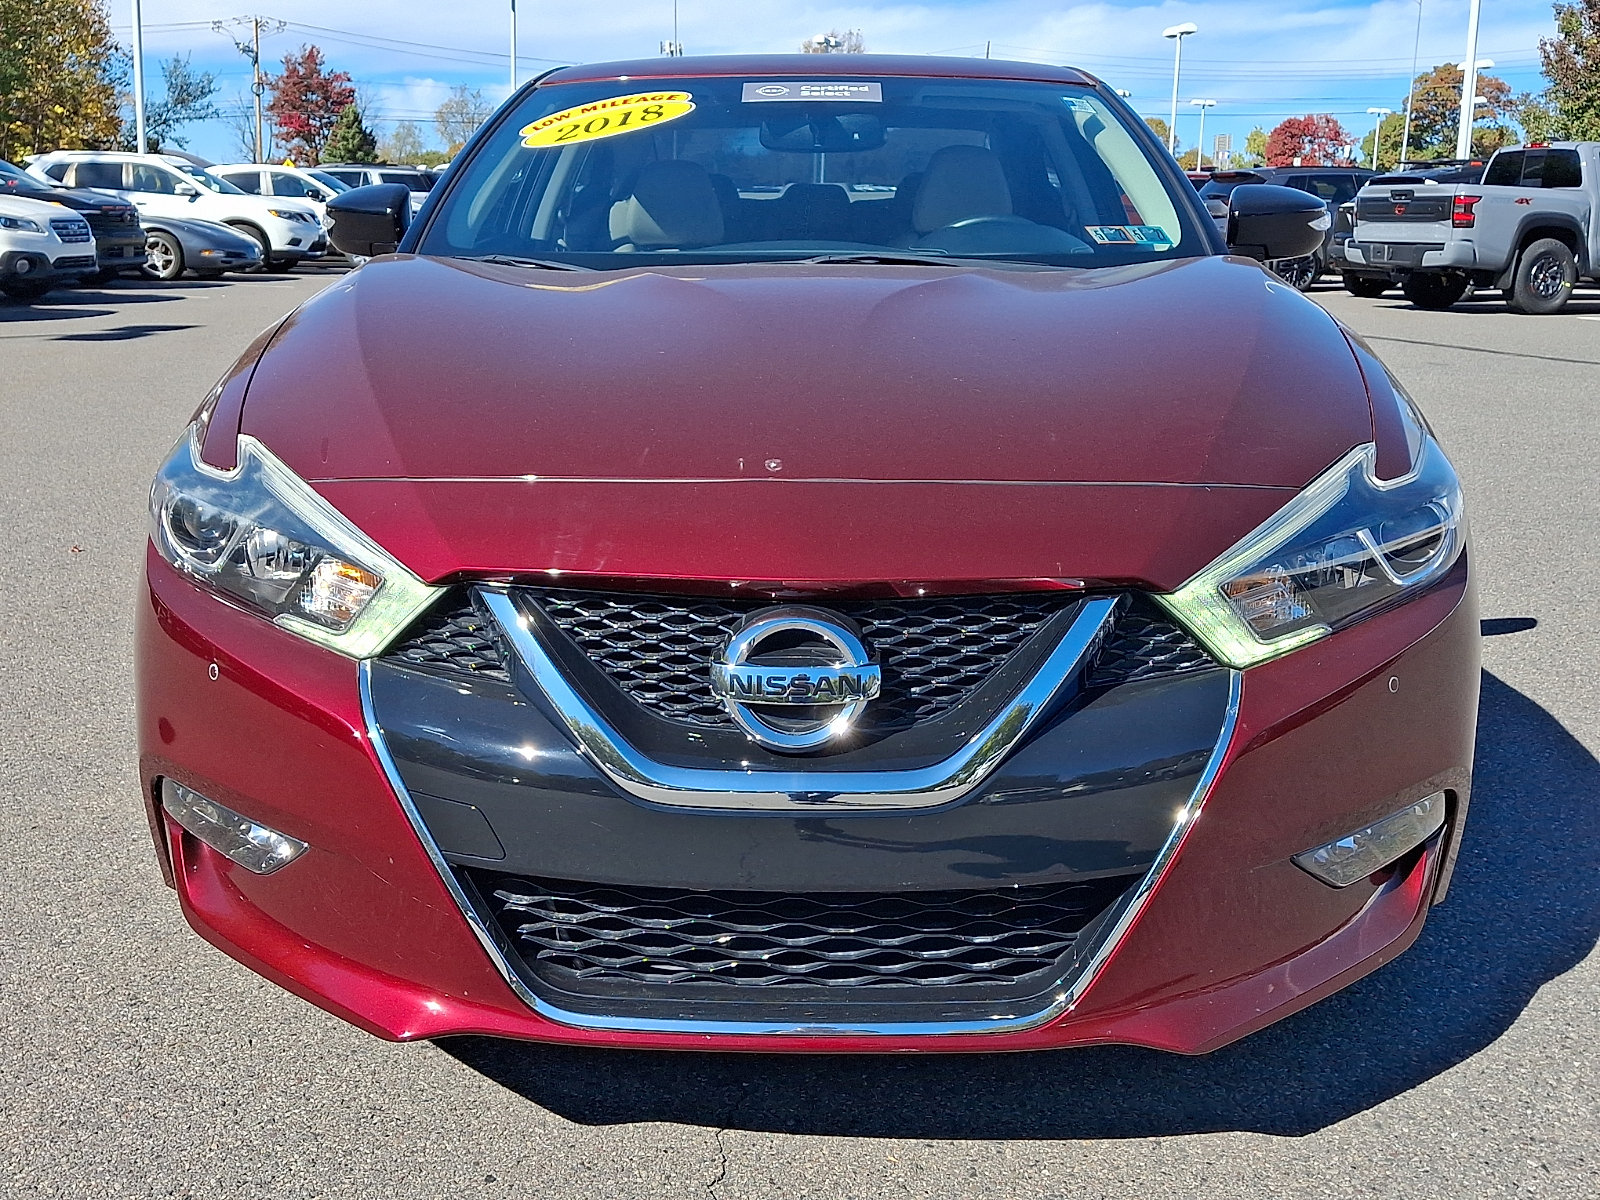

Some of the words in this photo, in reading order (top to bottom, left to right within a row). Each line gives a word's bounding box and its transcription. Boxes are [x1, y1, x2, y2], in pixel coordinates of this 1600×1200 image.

[533, 113, 571, 131] LOW
[581, 94, 681, 114] MILEAGE
[554, 104, 664, 142] 2018
[729, 673, 862, 698] NISSAN
